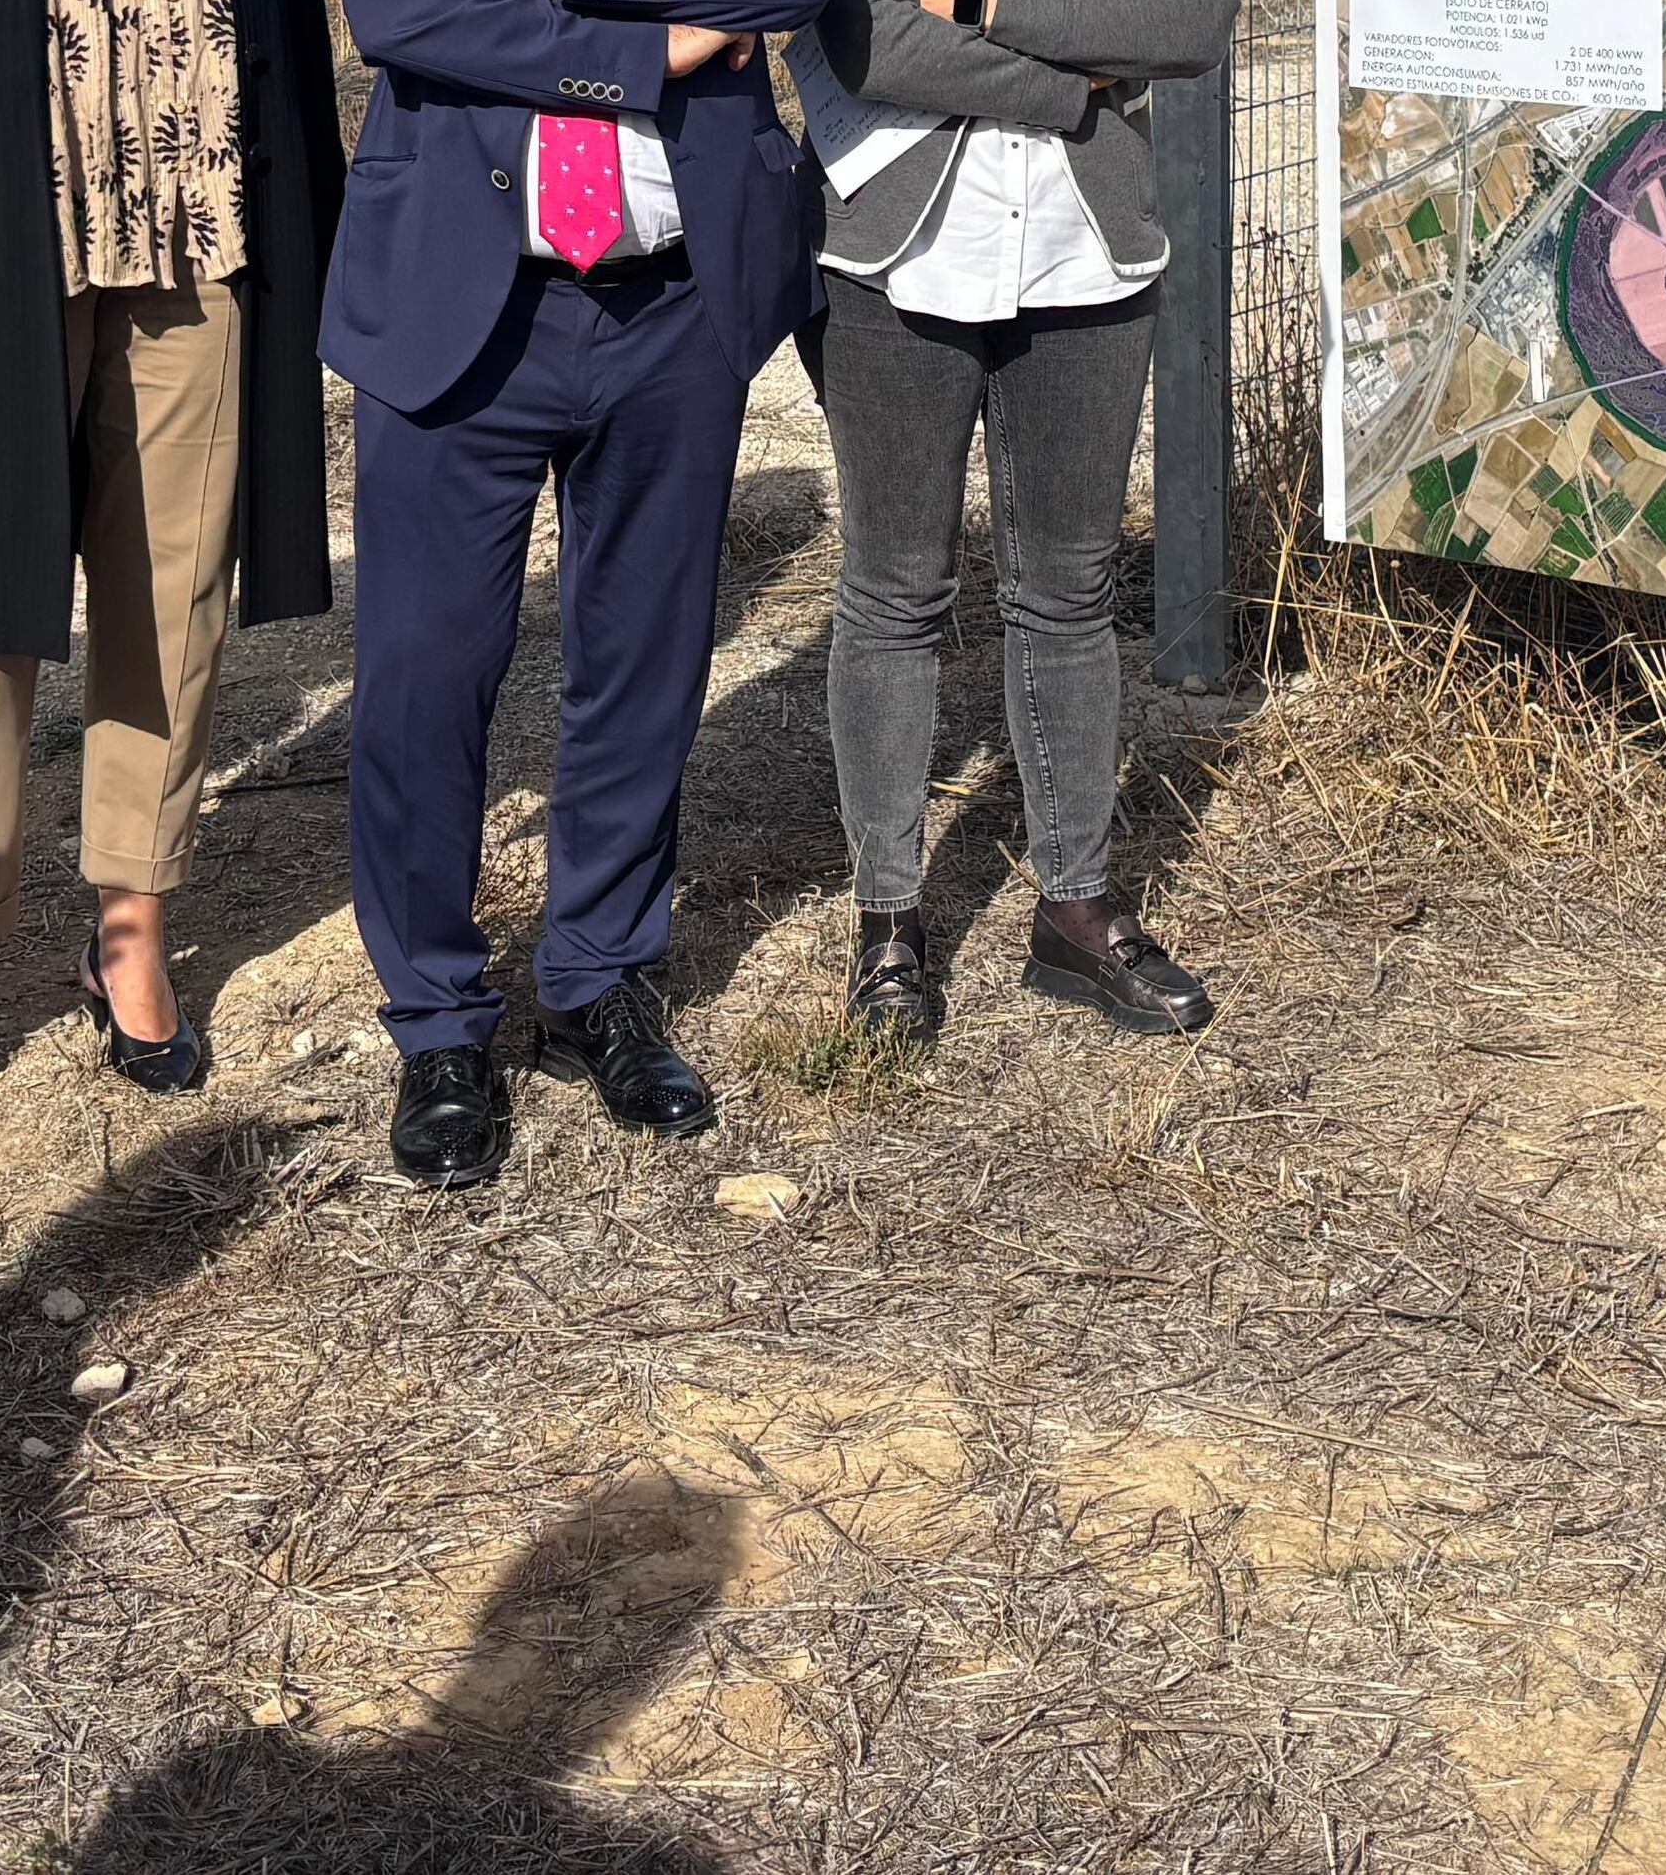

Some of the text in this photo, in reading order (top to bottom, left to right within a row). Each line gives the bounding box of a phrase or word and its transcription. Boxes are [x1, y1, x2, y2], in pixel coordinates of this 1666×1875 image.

[1446, 11, 1548, 27] POTENCIA: 1.021 kWp
[1364, 32, 1422, 46] VARIADORES
[1425, 36, 1502, 52] FOTOVOTAICOS:
[1570, 47, 1576, 57] 2
[1579, 48, 1592, 58] DE
[1596, 48, 1613, 59] 400
[1450, 26, 1544, 40] MODULOS: 1.536 ud
[1364, 46, 1642, 76] GENERACION: 1.731 MWh/año
[1361, 76, 1403, 88] AHORRO
[1407, 79, 1457, 92] ESTIMADO
[1461, 83, 1473, 93] EN
[1477, 84, 1531, 99] EMISIONES
[1535, 89, 1548, 100] DE
[1593, 94, 1611, 104] 600
[1362, 61, 1645, 92] ENERGIA AUTOCONSUMIDA: 857 MWh/año
